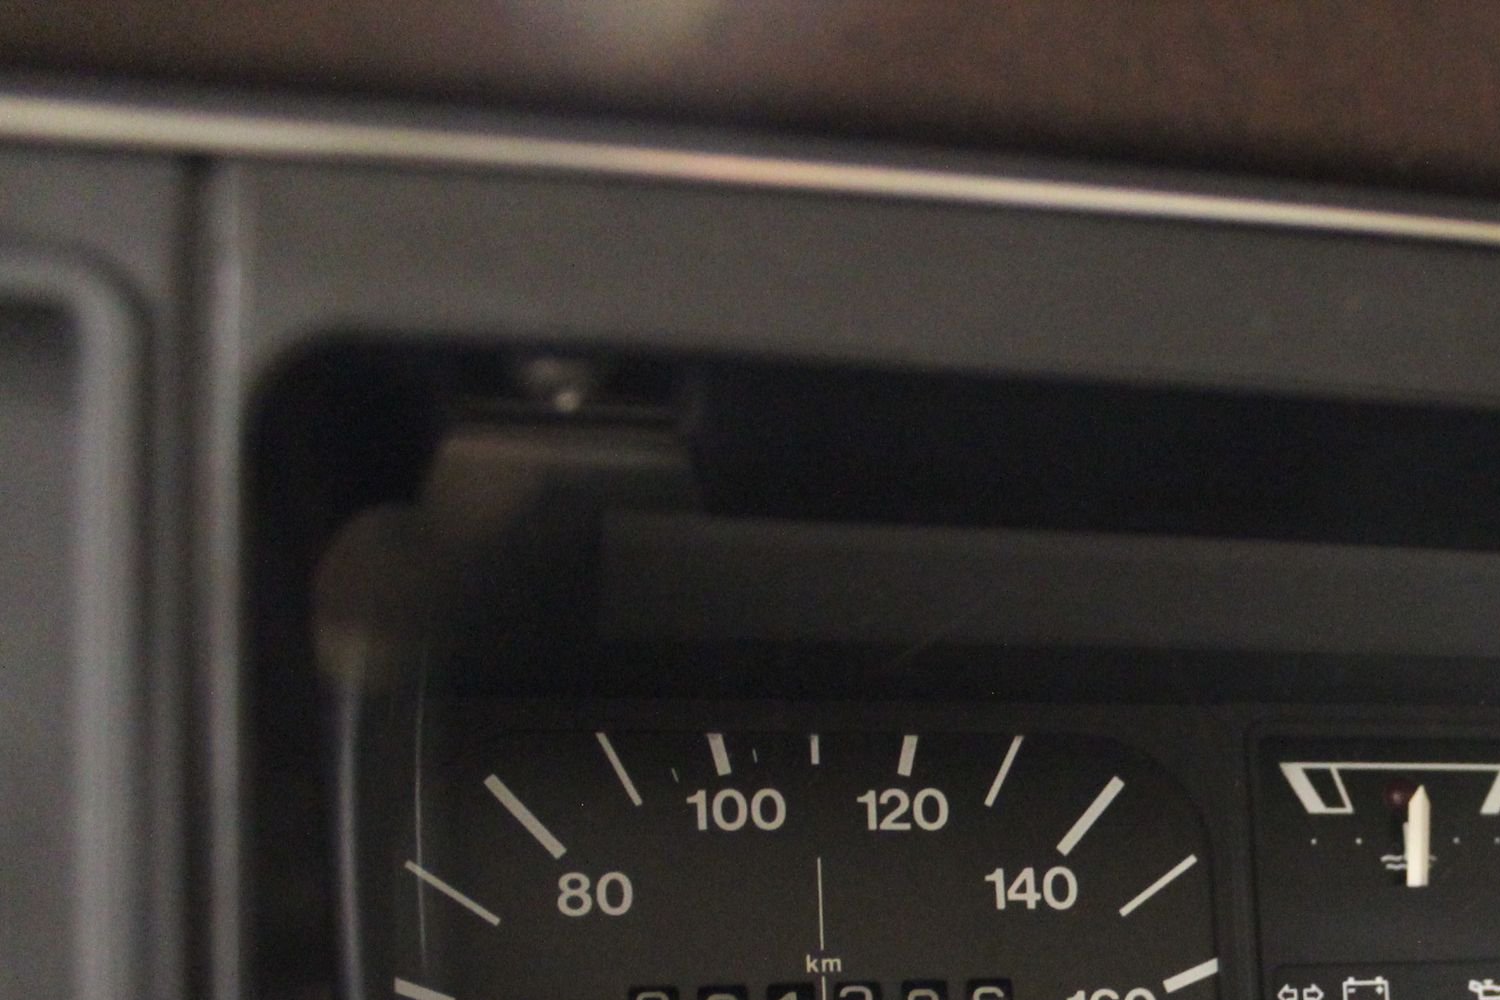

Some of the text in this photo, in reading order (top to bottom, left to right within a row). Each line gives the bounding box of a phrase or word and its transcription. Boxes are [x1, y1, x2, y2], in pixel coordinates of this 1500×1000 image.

[686, 786, 787, 832] 100
[857, 786, 949, 832] 120
[557, 871, 634, 917] 80
[985, 865, 1078, 911] 140
[805, 953, 842, 973] km
